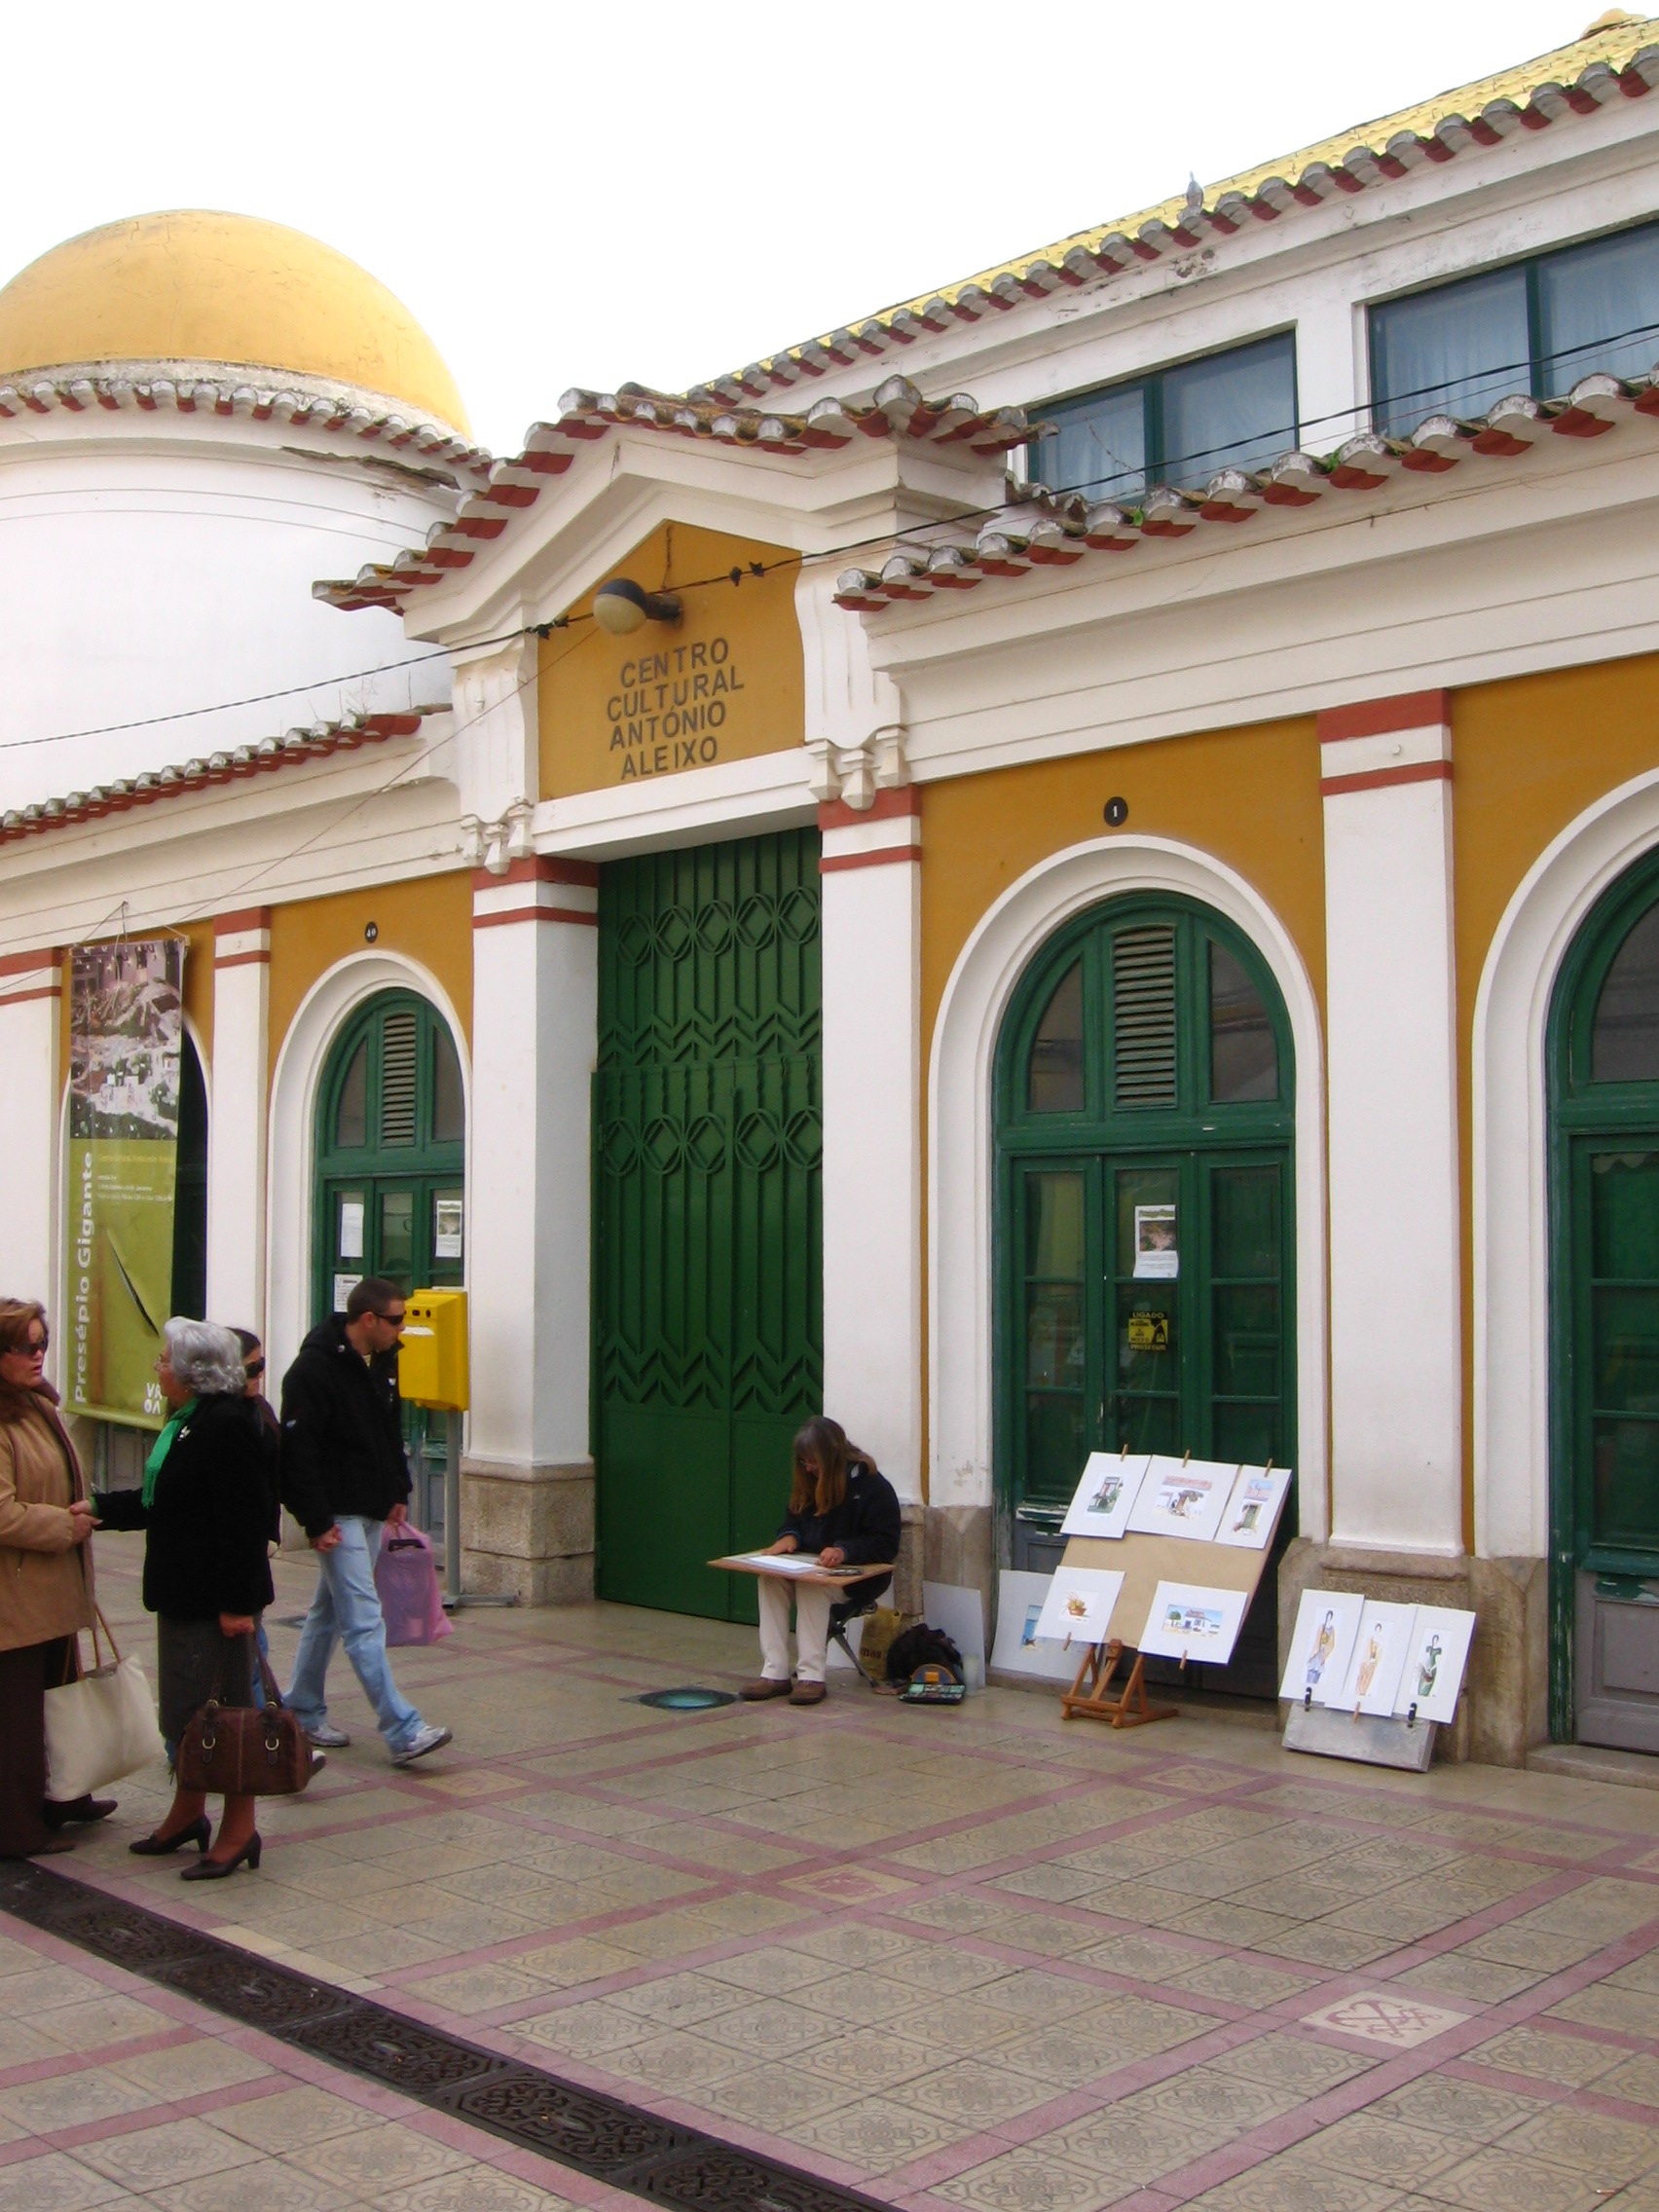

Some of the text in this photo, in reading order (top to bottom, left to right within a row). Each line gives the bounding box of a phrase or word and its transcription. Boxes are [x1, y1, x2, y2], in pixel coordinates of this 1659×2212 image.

[620, 638, 728, 688] CENTRO
[607, 665, 745, 722] CULTURAL
[609, 700, 726, 752] ANTÓNIO
[621, 736, 719, 780] ALEIXO
[74, 1151, 94, 1403] Presépio Gigante
